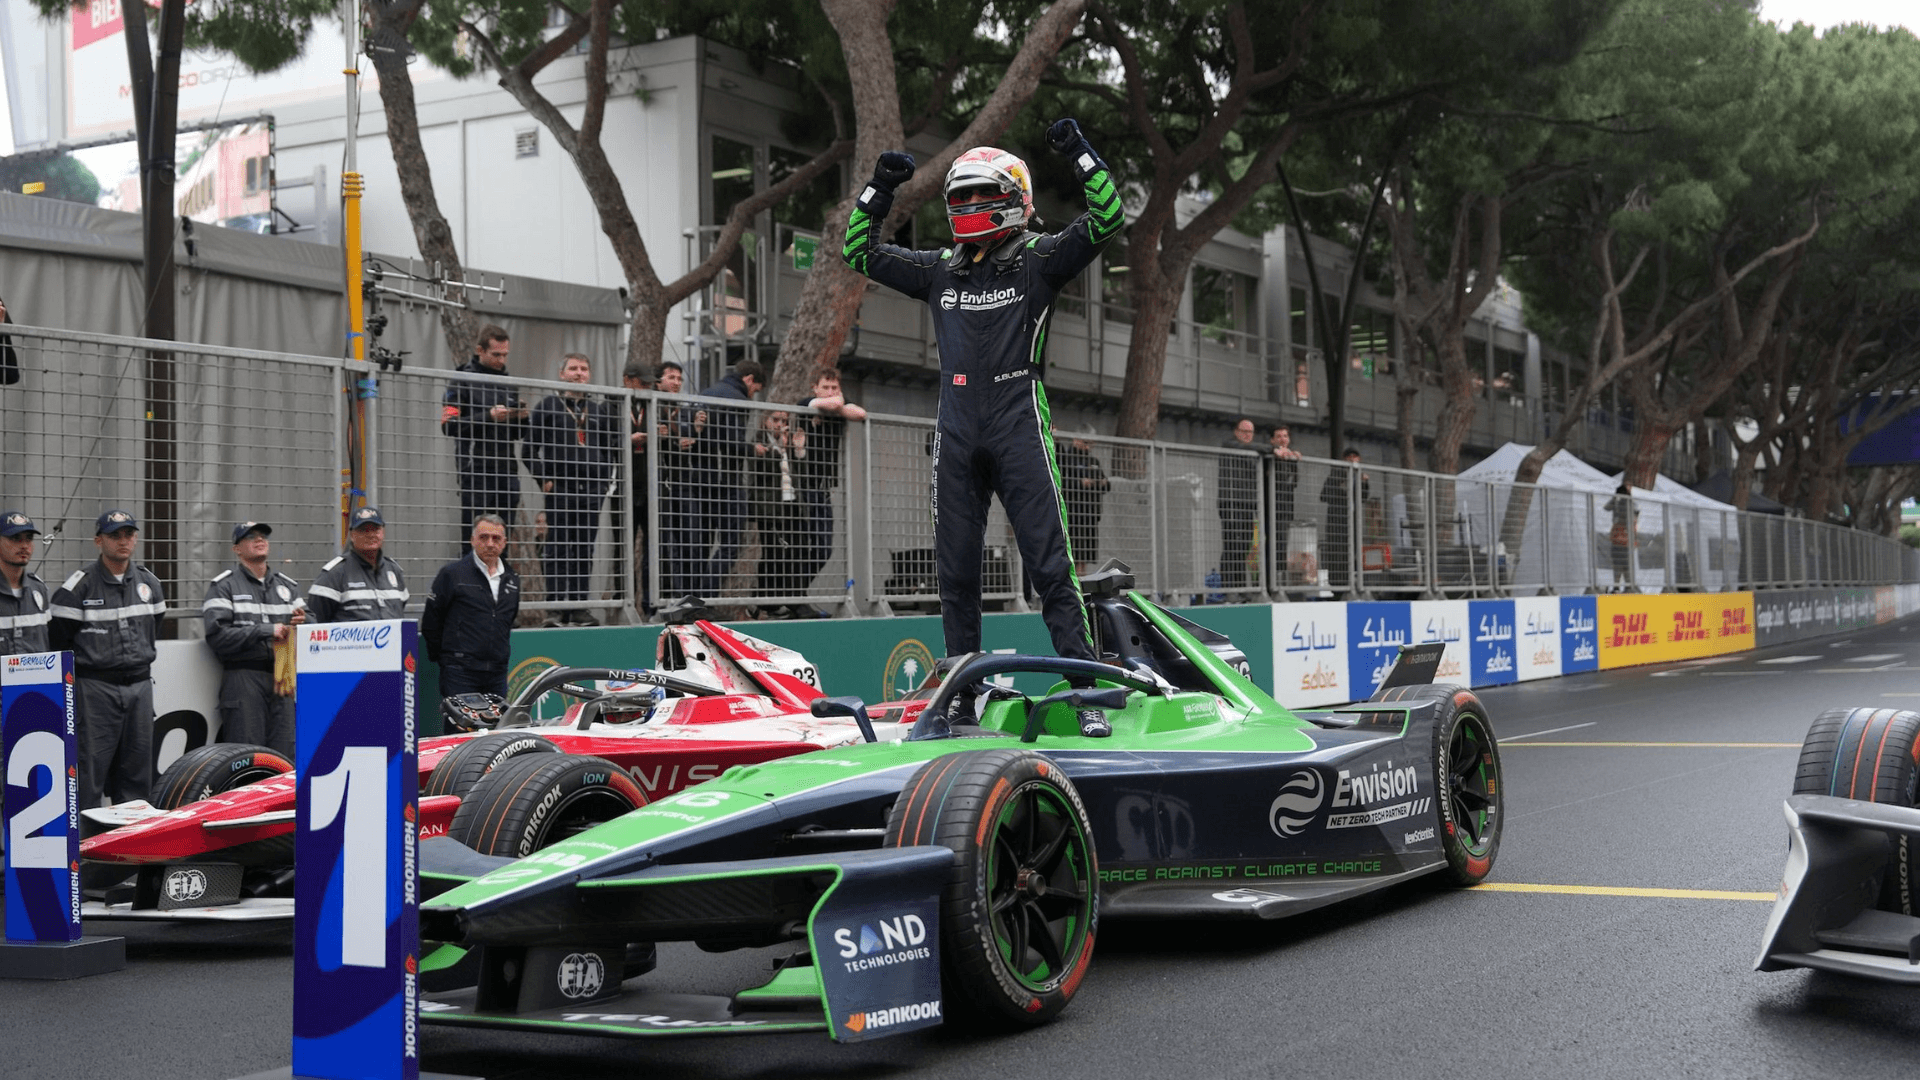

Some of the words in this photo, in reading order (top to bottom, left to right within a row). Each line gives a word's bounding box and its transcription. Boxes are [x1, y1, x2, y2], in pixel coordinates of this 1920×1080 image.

[960, 287, 1015, 304] Envision
[310, 629, 329, 642] ABB
[329, 626, 376, 642] FORMULA
[1611, 612, 1651, 648] DHL
[1673, 611, 1706, 642] DHL
[1720, 607, 1750, 637] DHL
[1486, 646, 1513, 674] sabic
[608, 670, 667, 685] NISSAN
[1301, 660, 1339, 691] sabic
[659, 706, 671, 714] 23
[1331, 760, 1418, 807] Envision
[7, 731, 68, 868] 2
[1330, 816, 1349, 826] NET
[1349, 813, 1370, 825] ZERO
[1371, 811, 1385, 823] TECH
[1385, 805, 1408, 819] PARTNER
[310, 746, 388, 968] 1
[1099, 868, 1147, 882] RACE
[1155, 865, 1236, 879] AGAINST
[1244, 862, 1317, 877] CLIMATE
[1323, 861, 1381, 873] CHANGE
[844, 947, 930, 973] TECHNOLOGIES
[562, 962, 599, 989] FIA
